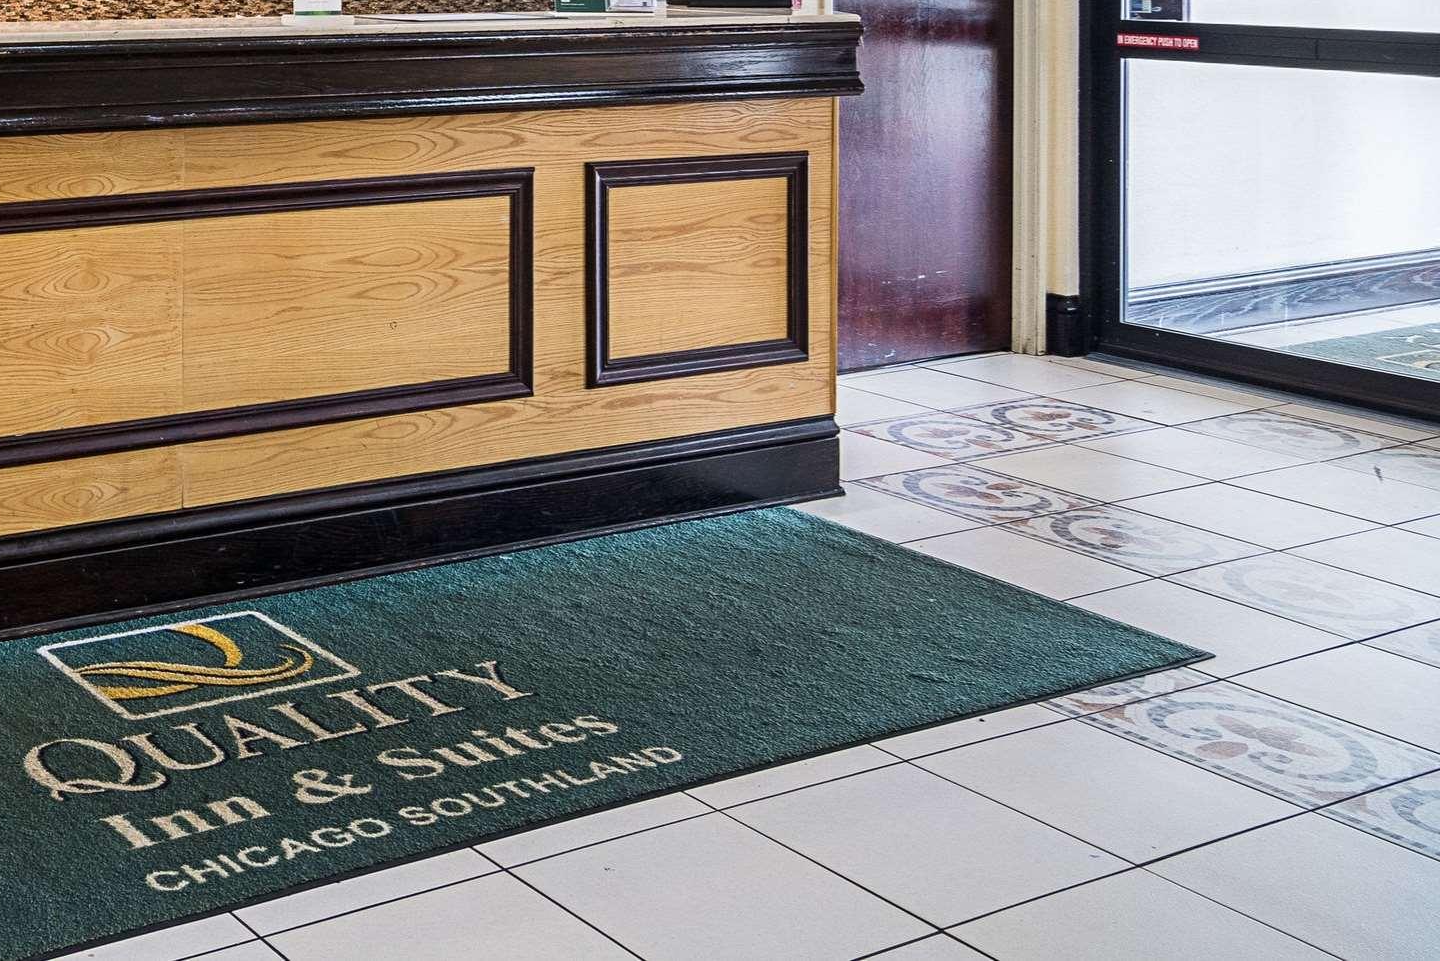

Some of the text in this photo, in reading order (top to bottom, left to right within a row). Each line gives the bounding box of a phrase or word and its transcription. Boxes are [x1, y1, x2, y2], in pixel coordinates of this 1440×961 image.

[1124, 36, 1157, 46] EMERGENCY
[1158, 37, 1173, 47] PUSH
[24, 660, 535, 803] QUALITY
[100, 714, 620, 851] Inn & Suites
[145, 745, 684, 894] CHICAGO SOUTHLAND
